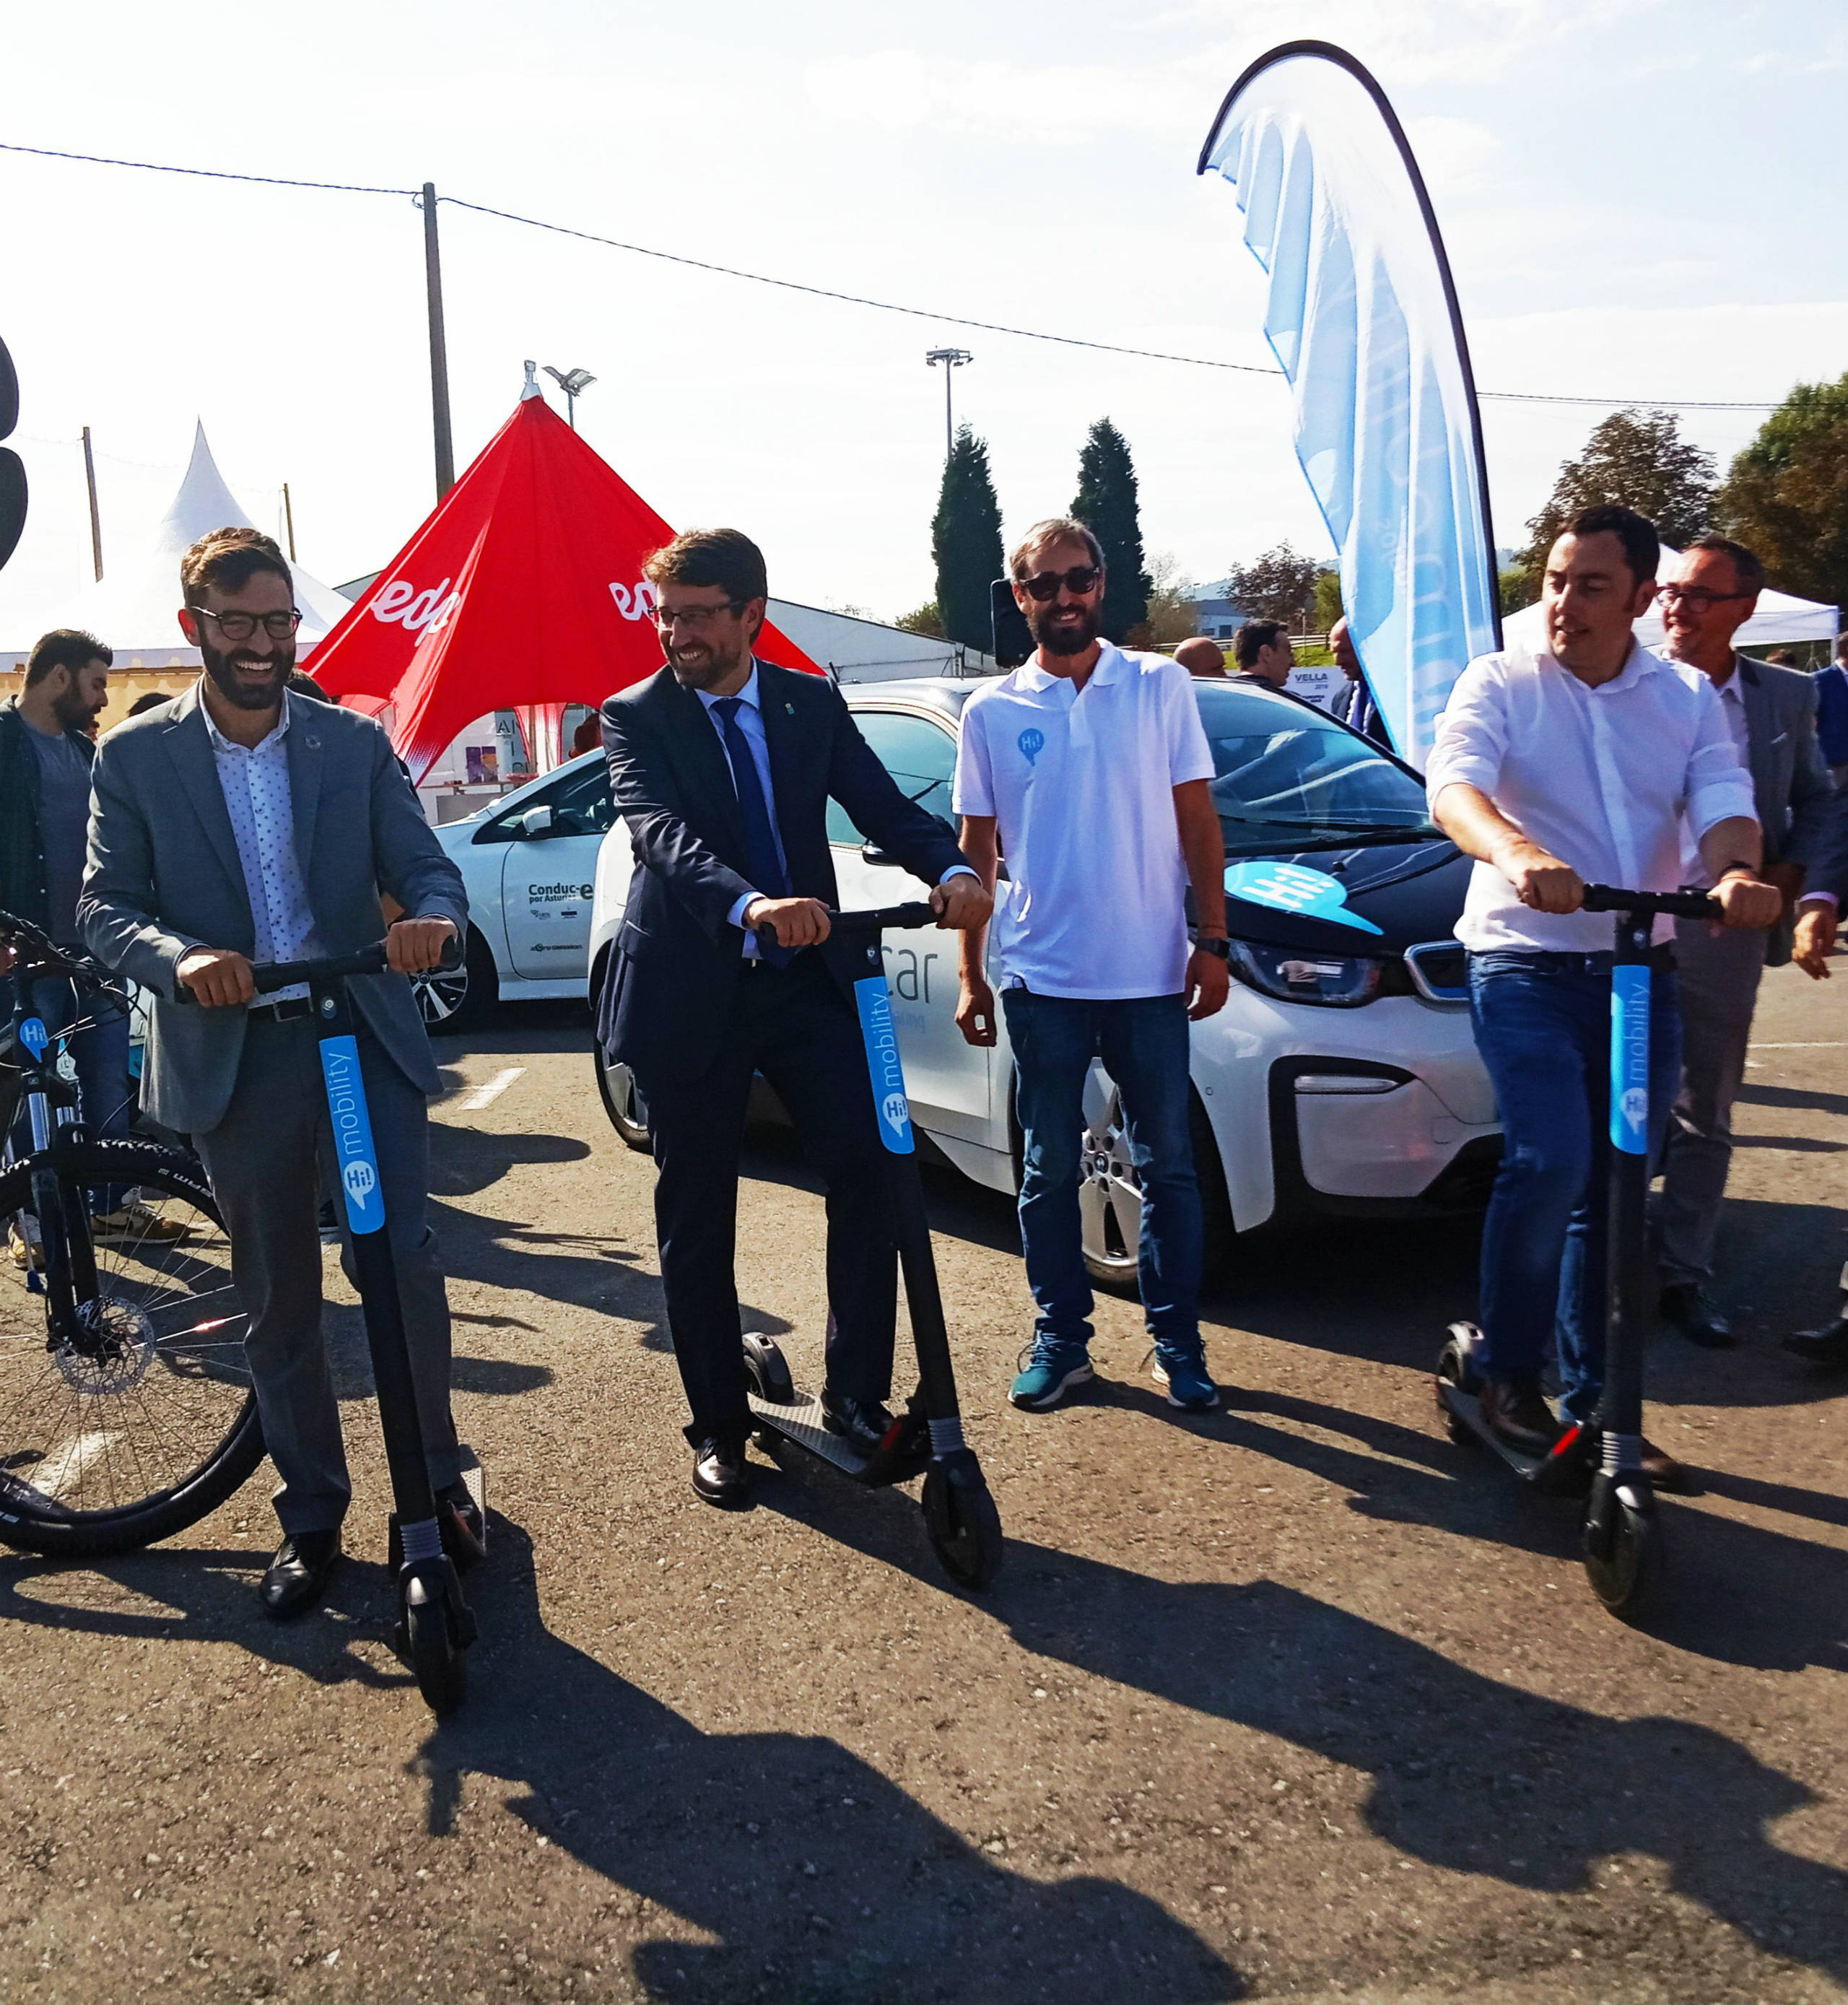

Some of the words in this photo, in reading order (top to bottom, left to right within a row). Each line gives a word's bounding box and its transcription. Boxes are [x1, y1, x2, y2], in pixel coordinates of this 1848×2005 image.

[370, 578, 461, 647] edp
[609, 567, 659, 628] ed
[1294, 673, 1328, 682] VELLA
[1021, 733, 1041, 751] Hi!
[528, 882, 593, 900] Conduc-e
[1241, 867, 1335, 908] Hi!
[871, 993, 900, 1087] mobility
[1624, 983, 1649, 1081] mobility
[328, 1053, 364, 1155] mobility
[886, 1100, 907, 1118] Hi!
[347, 1167, 372, 1190] Hi!
